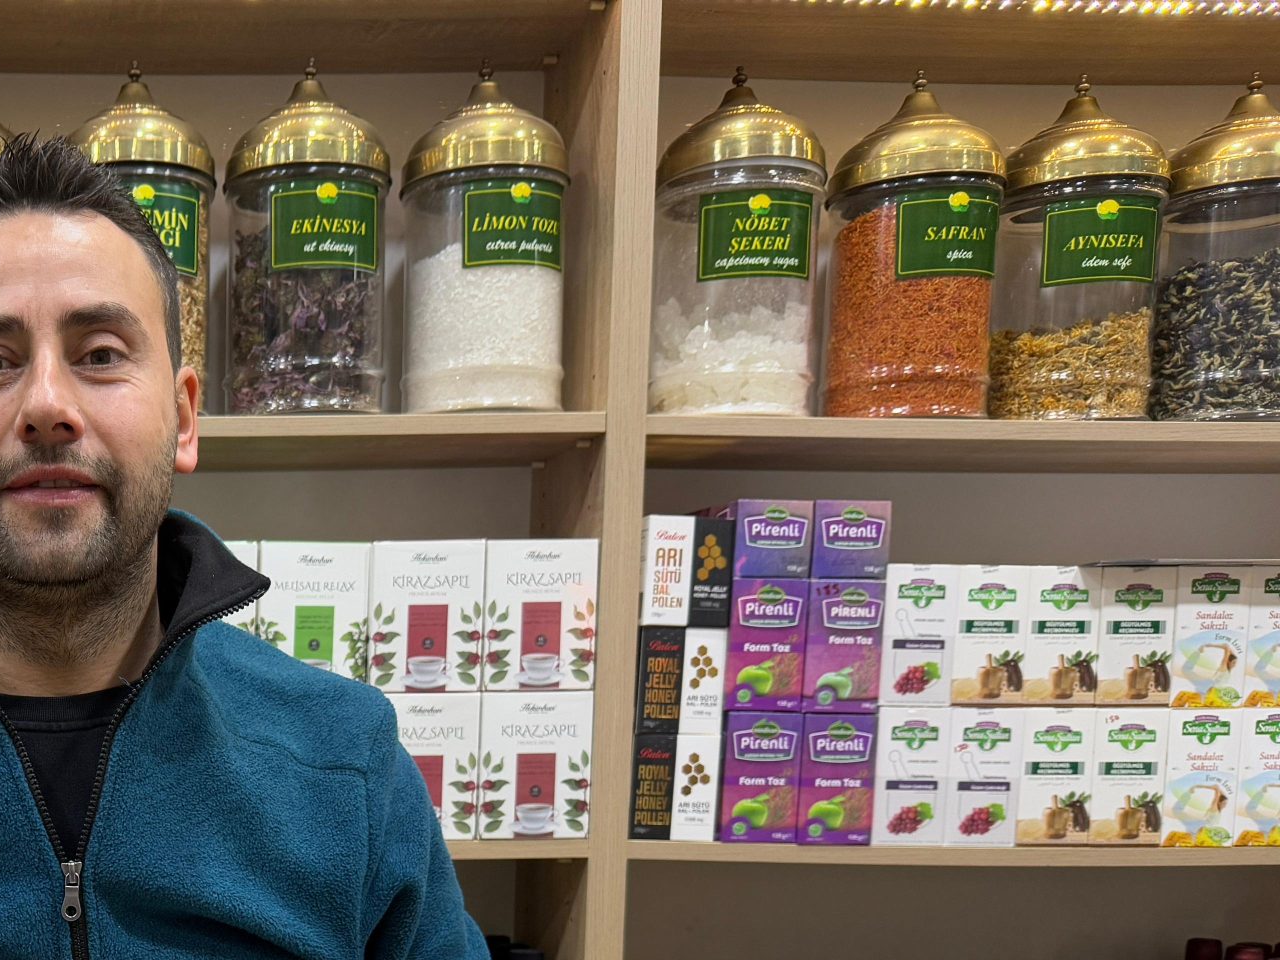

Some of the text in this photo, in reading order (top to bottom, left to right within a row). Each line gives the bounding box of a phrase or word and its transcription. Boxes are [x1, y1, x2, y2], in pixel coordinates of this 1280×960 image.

[290, 214, 368, 236] EKİNESYA
[472, 212, 528, 232] LİMON
[732, 214, 791, 232] NÖBET
[924, 225, 987, 241] SAFRAN
[729, 234, 792, 254] ŞEKERİ
[1063, 234, 1145, 251] AYNISEFA
[751, 522, 800, 537] Pirenli
[829, 523, 877, 538] Pirenli
[656, 548, 683, 567] ARI
[654, 568, 681, 584] SÜTÜ
[653, 584, 670, 596] BAL
[651, 596, 683, 608] POLEN
[745, 602, 794, 616] Pirenli
[830, 605, 876, 618] PİRENLİ
[743, 642, 770, 652] Form
[829, 635, 854, 645] Form
[647, 657, 680, 673] ROYAL
[645, 673, 677, 688] JELLY
[645, 689, 677, 704] HONEY
[643, 704, 679, 719] POLLEN
[400, 726, 430, 741] RAZ
[740, 736, 789, 750] Pirenli
[816, 738, 864, 751] Pirenli
[637, 764, 672, 780] ROYAL
[636, 780, 669, 795] JELLY
[739, 777, 765, 786] Form
[815, 778, 841, 787] Form
[635, 795, 669, 810] HONEY
[634, 810, 670, 825] POLLEN
